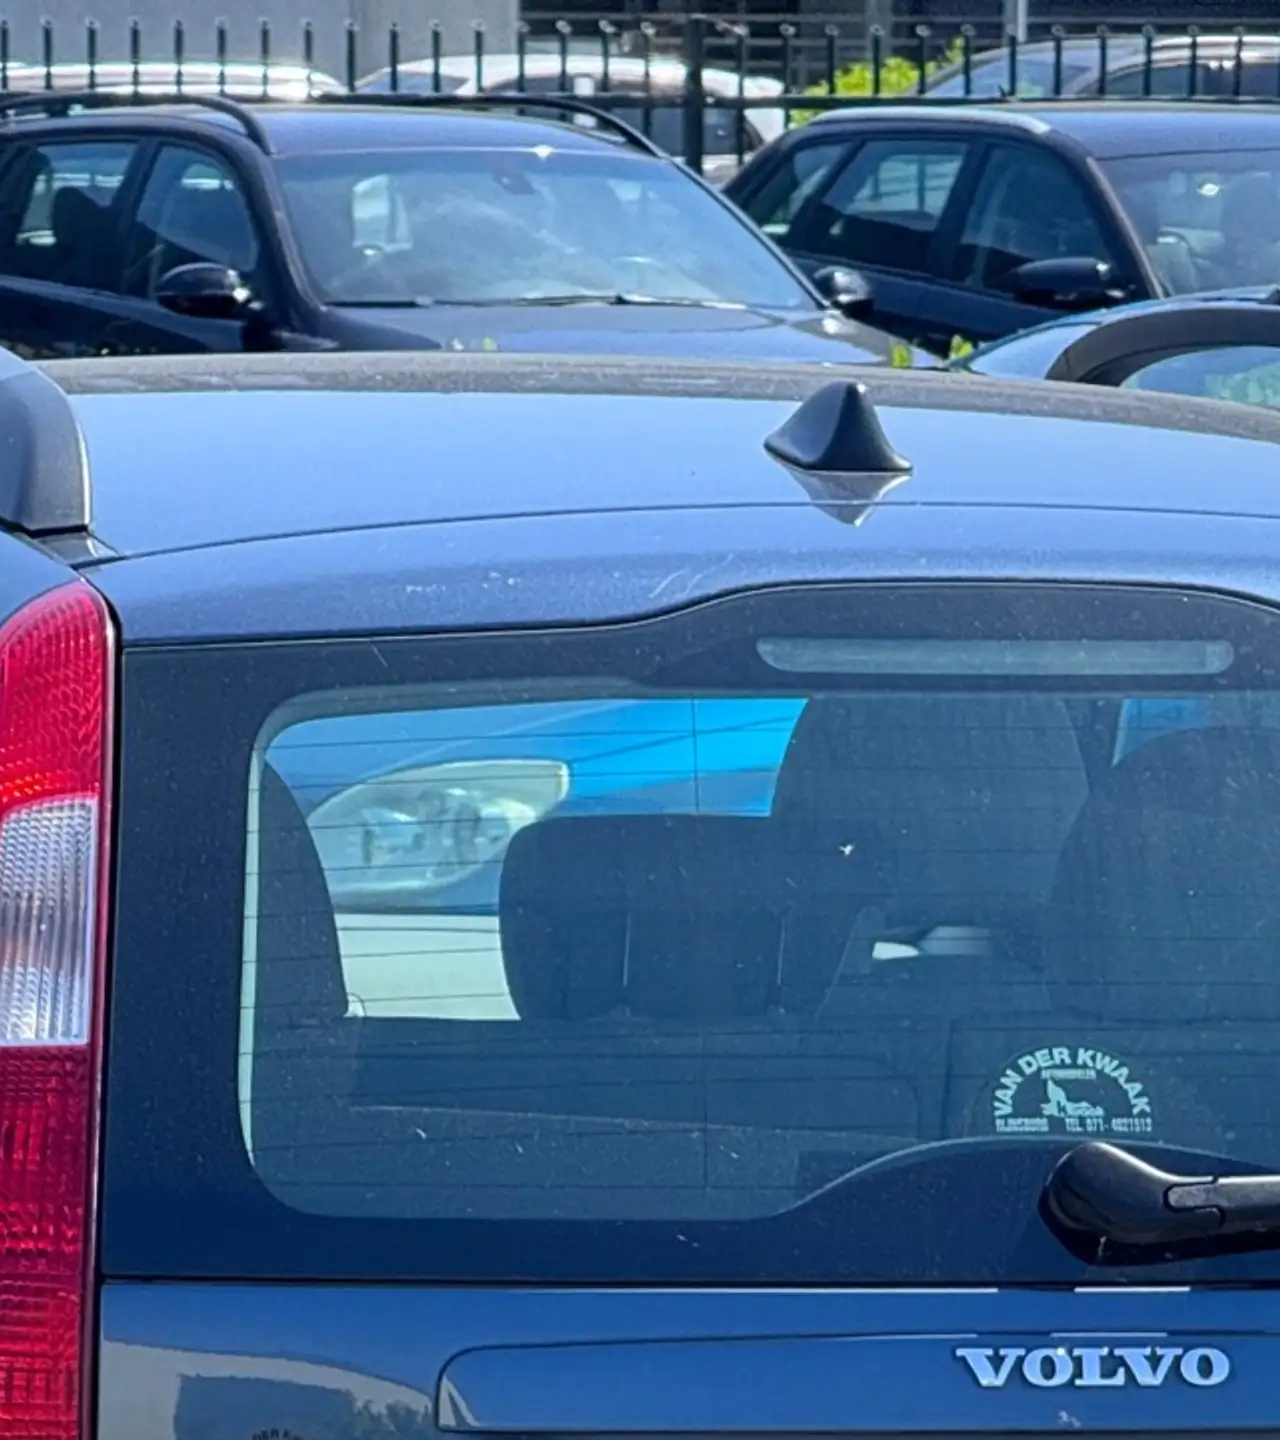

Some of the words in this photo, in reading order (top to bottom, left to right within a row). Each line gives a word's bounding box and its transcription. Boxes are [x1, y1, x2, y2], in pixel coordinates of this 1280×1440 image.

[993, 1067, 1024, 1117] VAN
[1017, 1048, 1072, 1075] DER
[1076, 1047, 1152, 1116] KWAAK
[955, 1346, 1231, 1387] VOLVO
